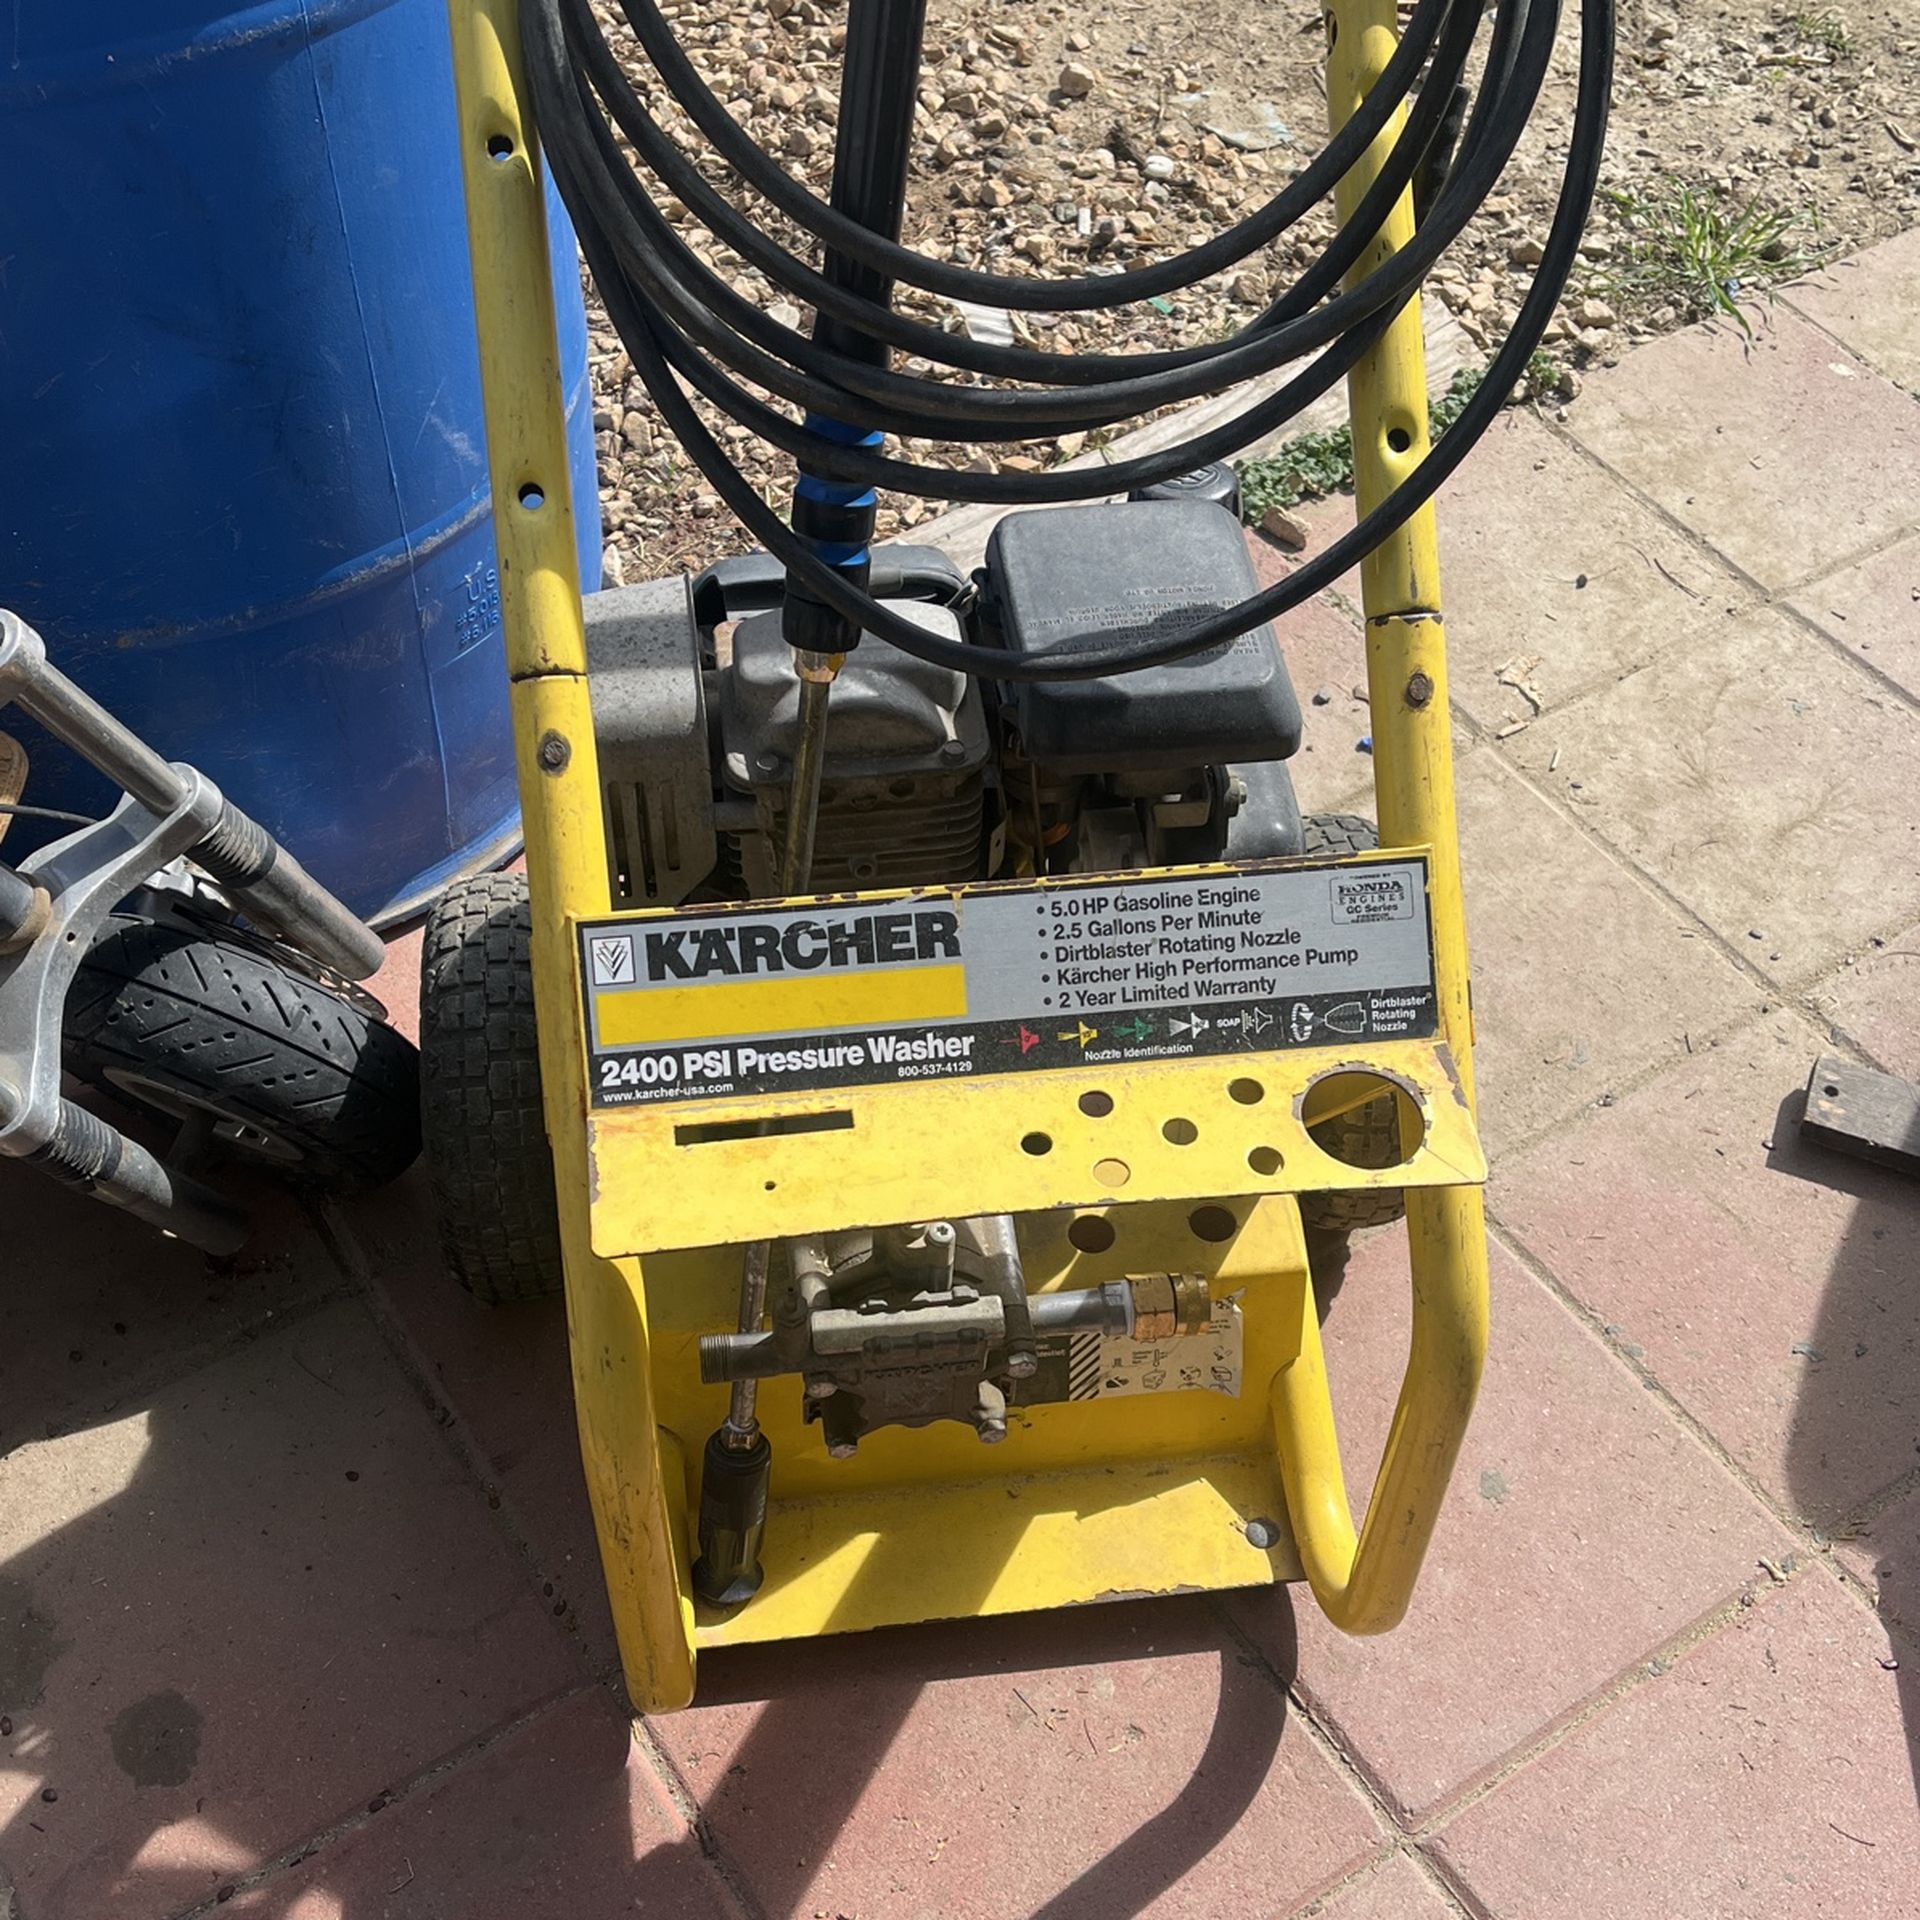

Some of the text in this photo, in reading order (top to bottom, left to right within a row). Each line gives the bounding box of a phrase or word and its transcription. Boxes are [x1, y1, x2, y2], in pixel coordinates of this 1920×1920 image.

[1338, 880, 1404, 894] HONDA
[1051, 887, 1261, 918] 5.0 HP Gasoline Engine
[1337, 892, 1405, 905] ENGINES
[1365, 903, 1399, 913] Series
[1053, 909, 1262, 940] 2.5 Gallons Per Minute
[646, 911, 961, 980] KÄRCHER
[1055, 928, 1302, 963] Dirtblaster Rotating Nozzle
[1057, 947, 1359, 986] Kärcher High Performance Pump
[1059, 976, 1277, 1009] 2 Year Limited Warranty
[1216, 1017, 1241, 1029] SOAP
[1372, 1008, 1416, 1021] Rotating
[1372, 1021, 1408, 1033] Nozzle
[600, 1032, 975, 1087] 2400 PSI Pressure Washer
[1085, 1044, 1194, 1061] Nozzle Identification
[898, 1061, 972, 1078] 800-537-4129
[603, 1081, 734, 1103] www.karcher-usa.com
